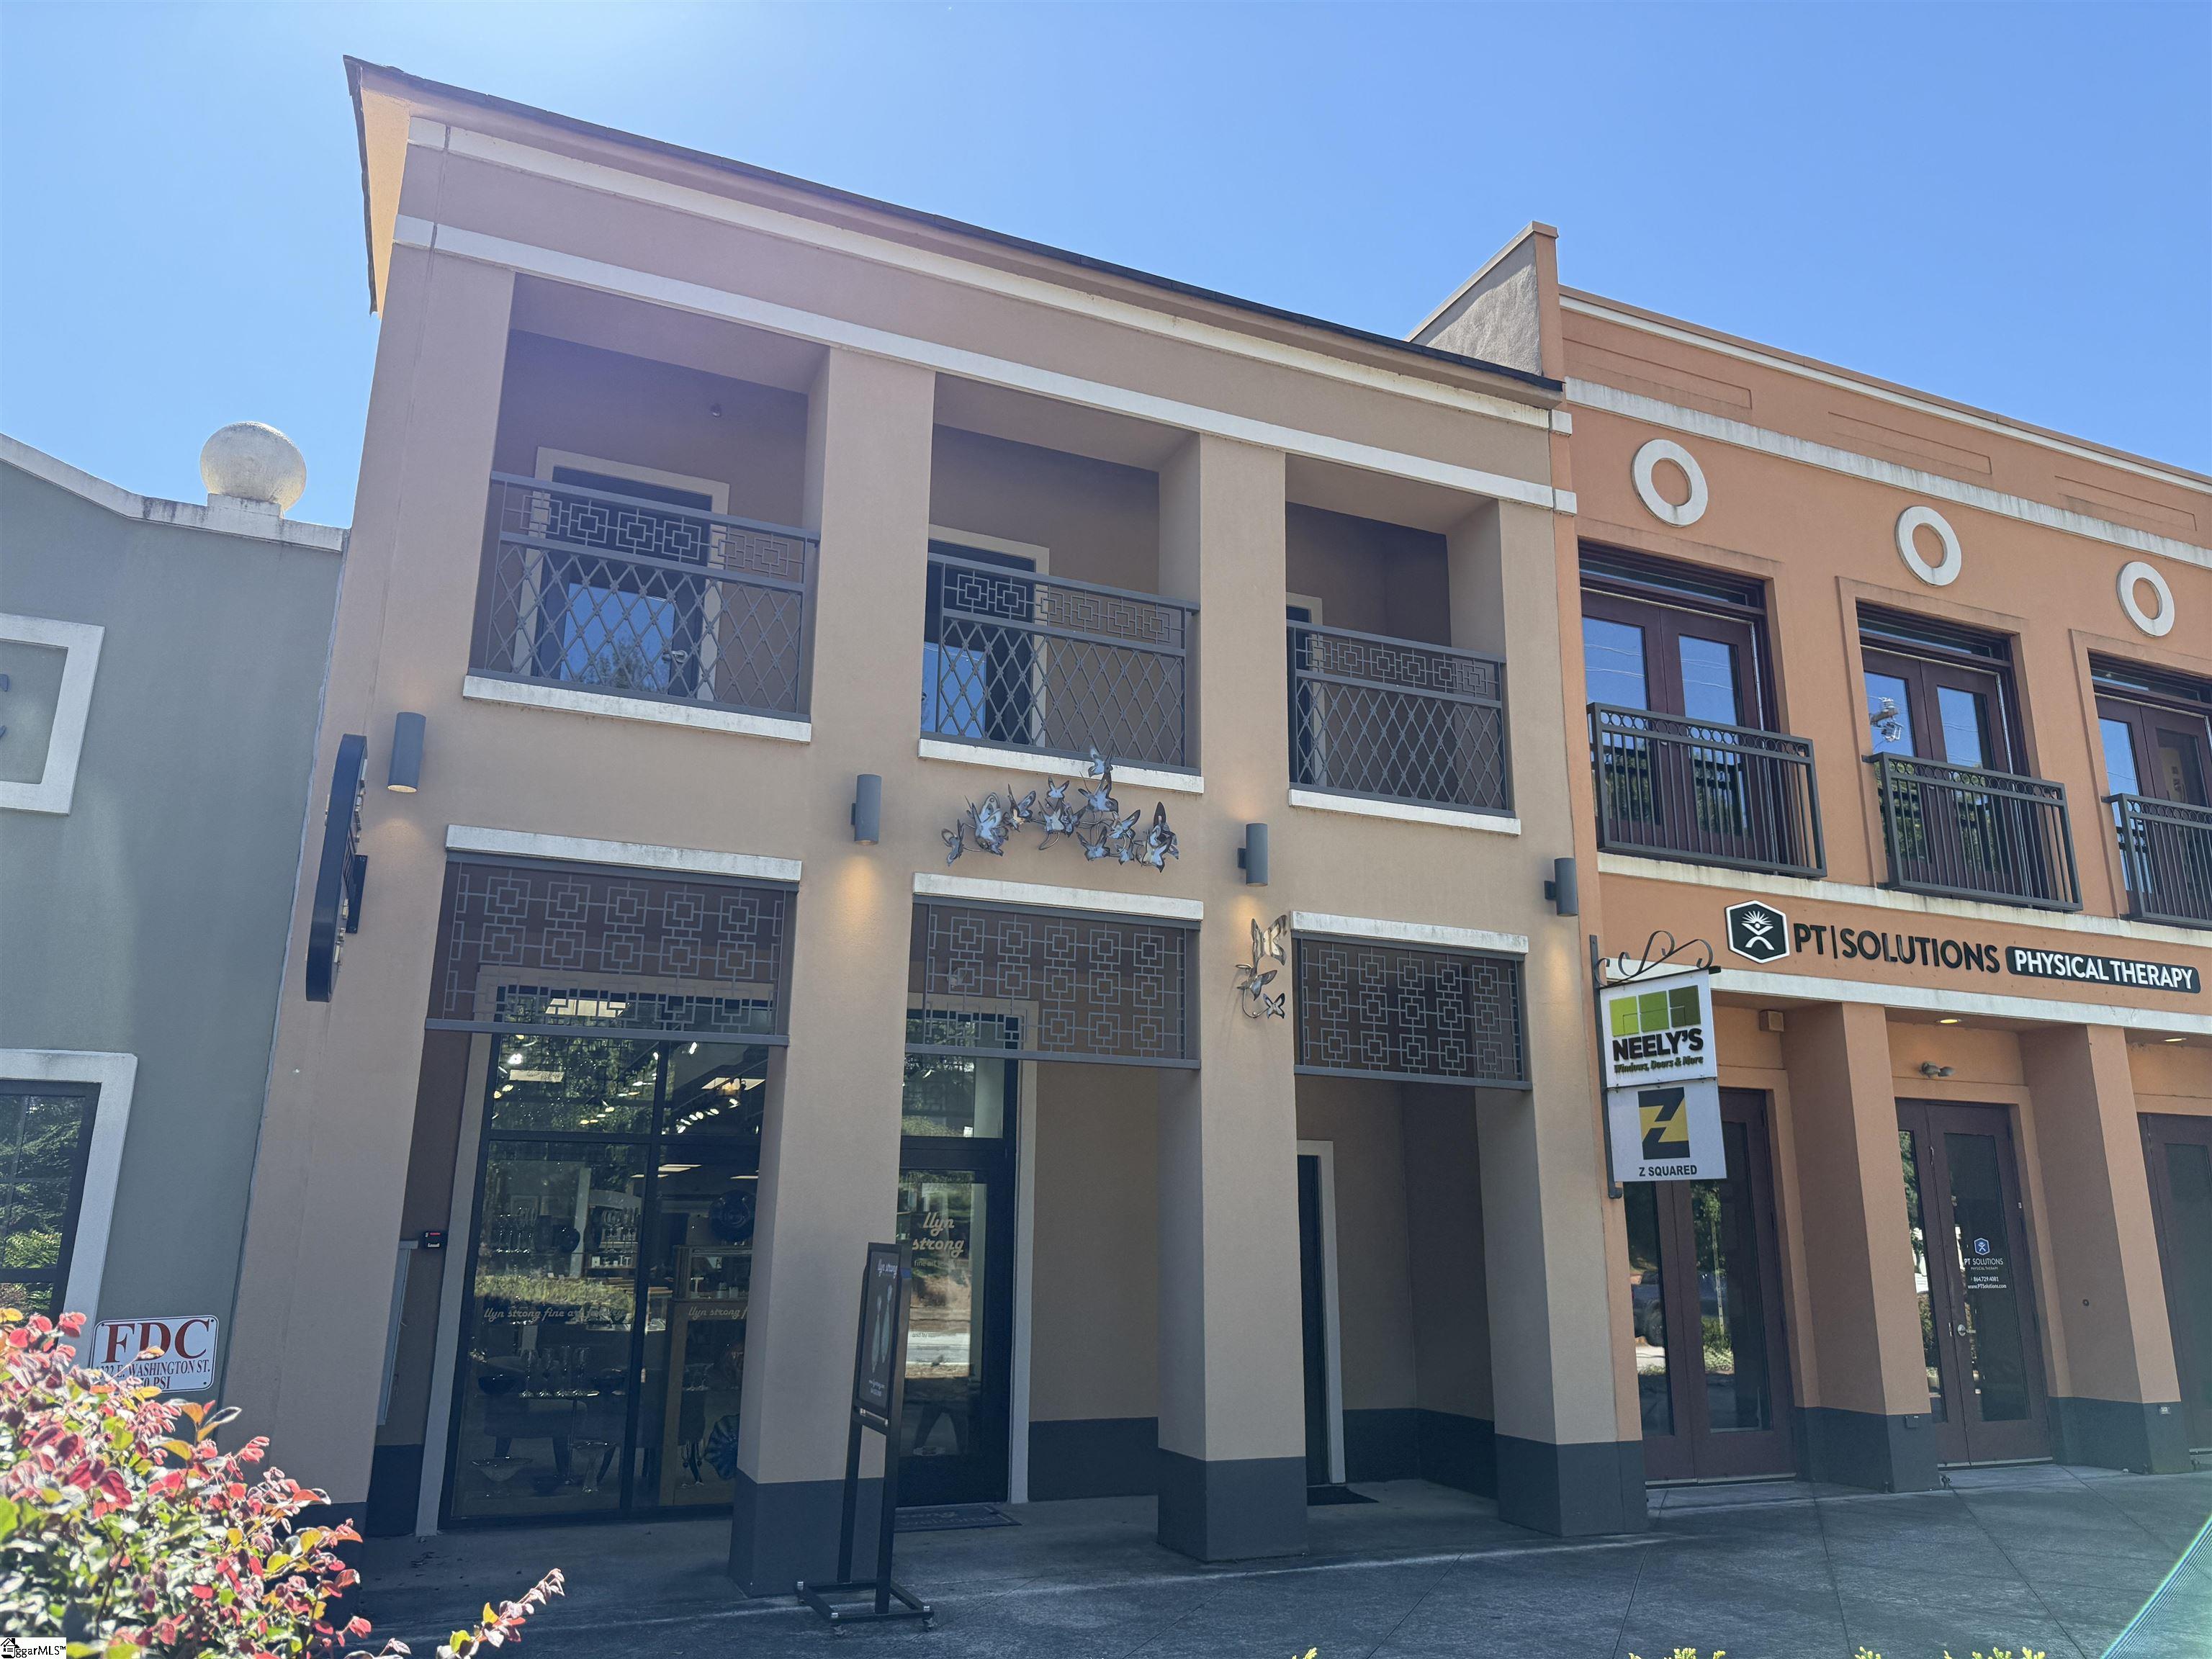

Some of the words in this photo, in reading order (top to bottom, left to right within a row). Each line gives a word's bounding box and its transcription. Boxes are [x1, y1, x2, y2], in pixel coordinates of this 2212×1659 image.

[1840, 928, 2000, 974] SOLUTIONS
[2014, 949, 2110, 981] PHYSICAL
[2109, 960, 2193, 989] THERAPY
[1612, 1028, 1704, 1061] NEELY'S
[1614, 1062, 1650, 1074] Windows,
[1650, 1059, 1674, 1070] Doors
[1674, 1057, 1682, 1066] &
[1682, 1056, 1704, 1066] More
[1639, 1166, 1646, 1177] Z
[1648, 1164, 1697, 1177] SQUARED
[922, 1212, 955, 1237] llyn
[912, 1237, 965, 1258] strong
[507, 1310, 541, 1322] strong
[541, 1307, 565, 1321] fine
[101, 1318, 210, 1363] FDC
[128, 1360, 195, 1377] WASHINGTON
[196, 1359, 210, 1373] ST.
[153, 1376, 171, 1390] PSI
